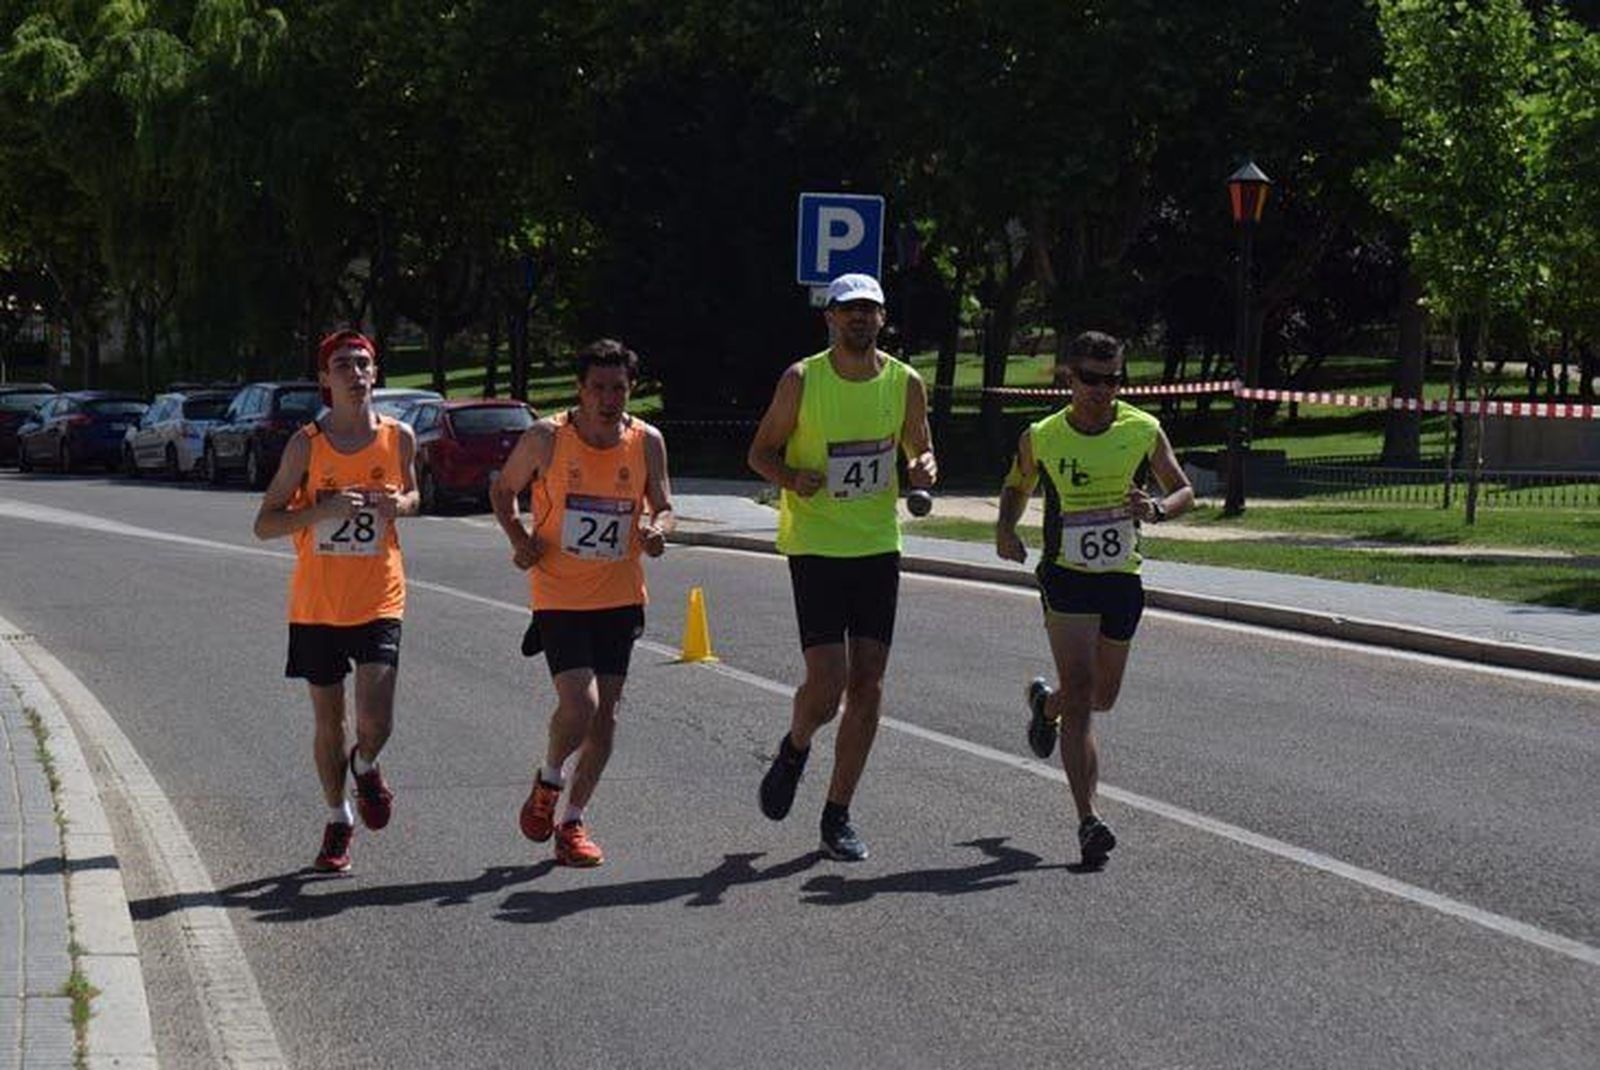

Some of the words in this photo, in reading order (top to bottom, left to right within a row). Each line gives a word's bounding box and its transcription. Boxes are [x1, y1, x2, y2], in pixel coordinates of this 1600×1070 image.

[816, 205, 865, 273] P
[843, 459, 879, 488] 41
[330, 512, 375, 542] 28
[577, 516, 619, 549] 24
[1081, 528, 1121, 560] 68
